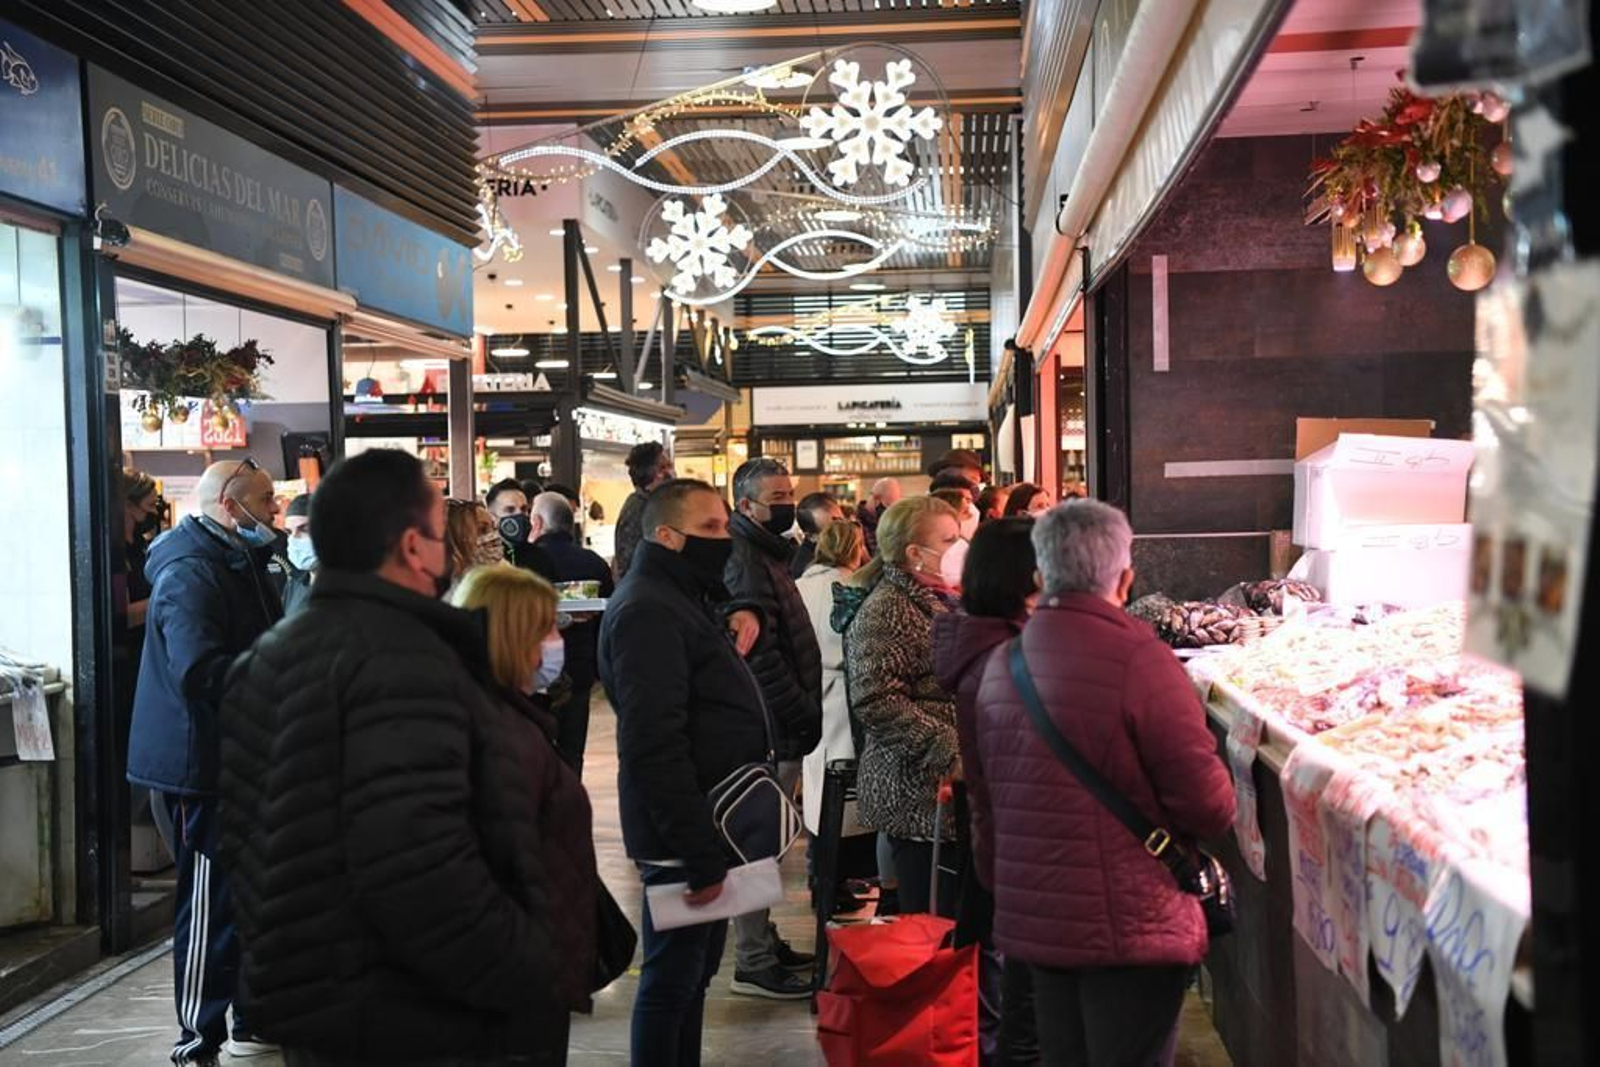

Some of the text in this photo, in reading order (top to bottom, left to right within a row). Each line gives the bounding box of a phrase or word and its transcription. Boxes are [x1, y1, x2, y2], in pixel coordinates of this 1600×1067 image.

[144, 132, 232, 200] DELICIAS
[234, 172, 267, 214] DEL
[267, 186, 301, 226] MAR
